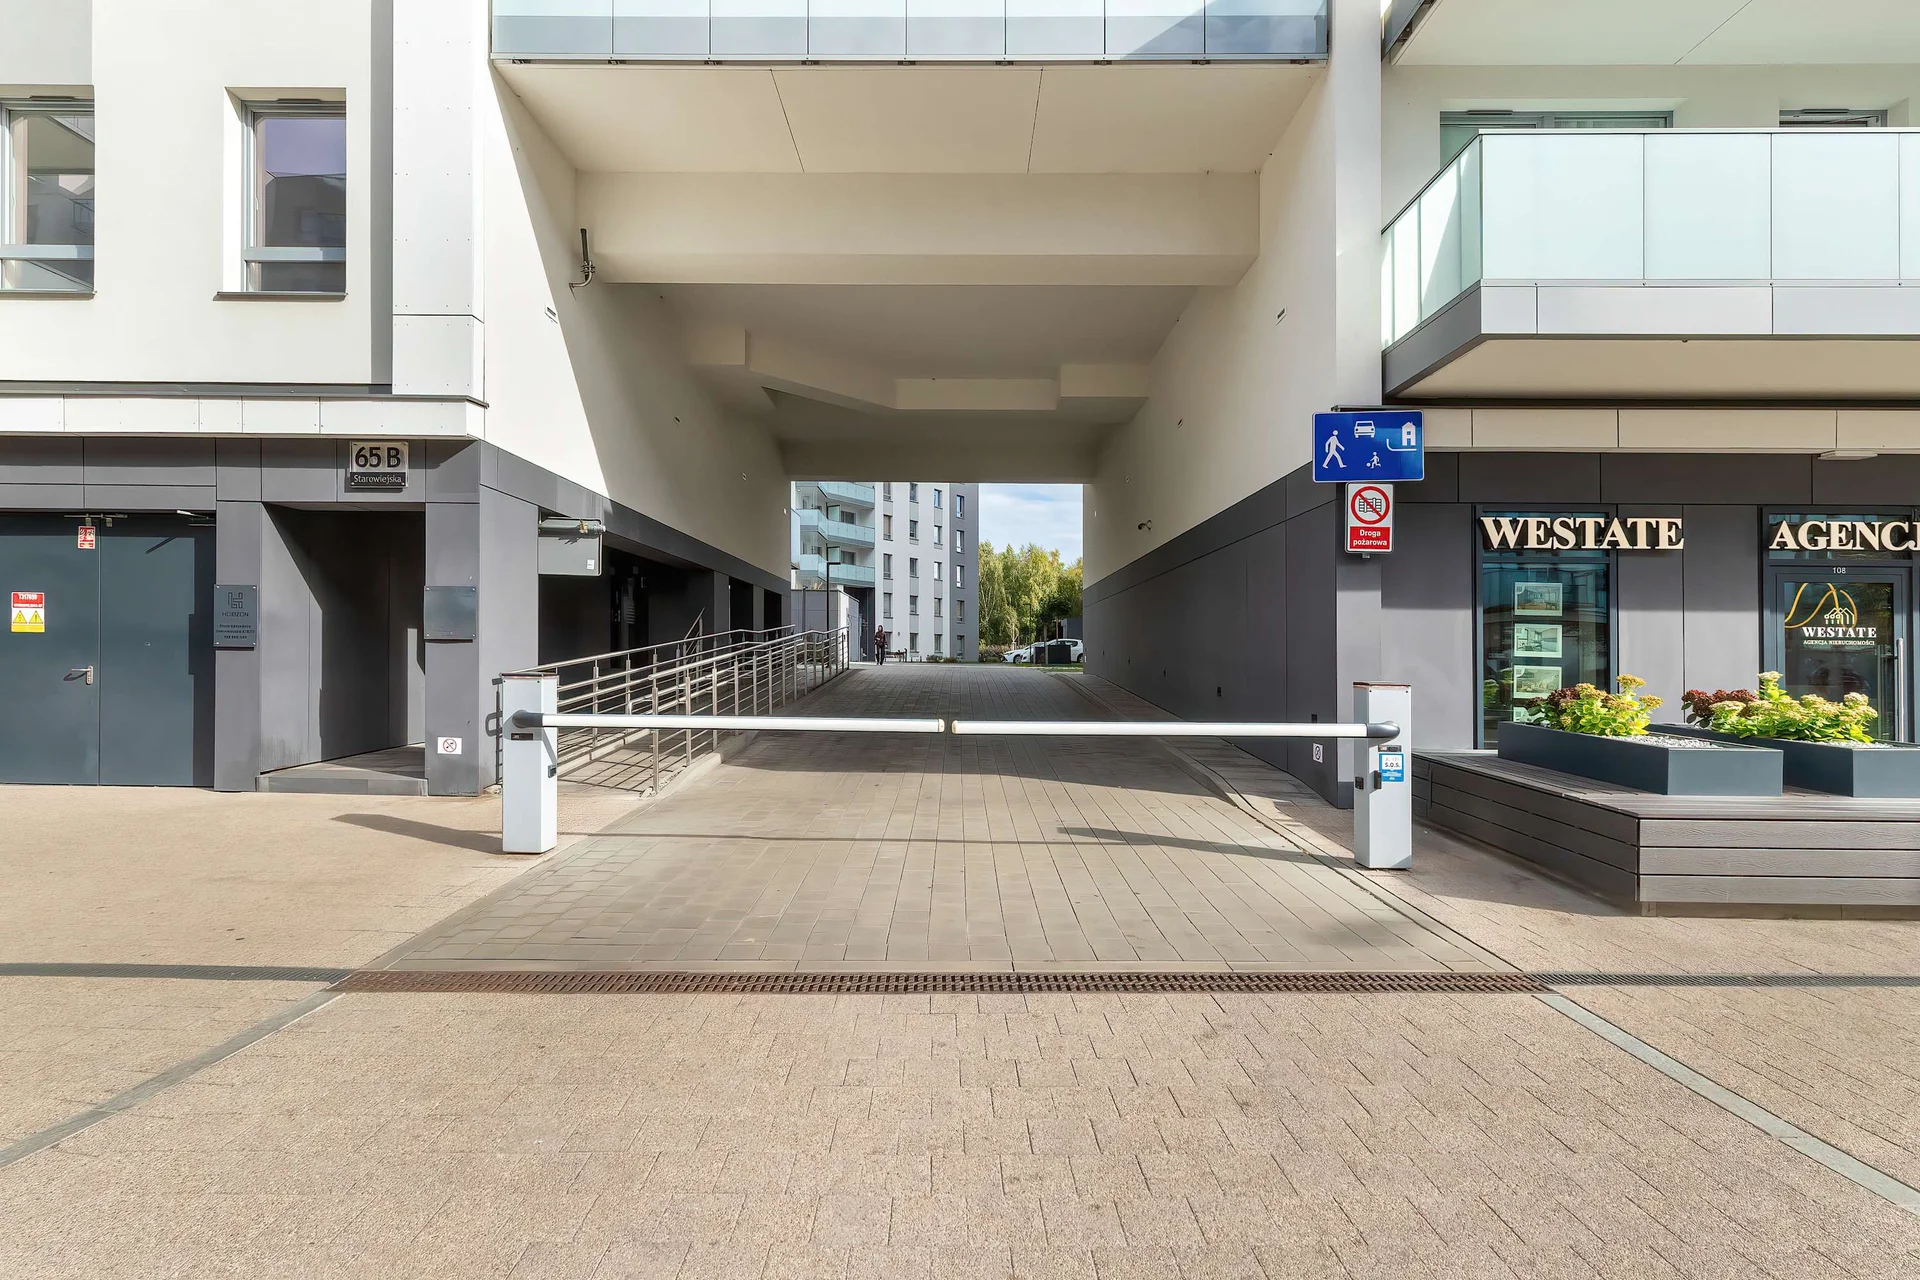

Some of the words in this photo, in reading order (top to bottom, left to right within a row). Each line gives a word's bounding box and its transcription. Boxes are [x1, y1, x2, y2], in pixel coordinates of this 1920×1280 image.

[355, 446, 382, 468] 65
[387, 446, 401, 468] B
[353, 474, 402, 485] Starowiejska
[1359, 529, 1381, 538] Droga
[1480, 516, 1685, 550] WESTATE
[1352, 538, 1388, 547] pożarowa
[1832, 566, 1847, 574] 108
[1802, 626, 1877, 638] WESTATE
